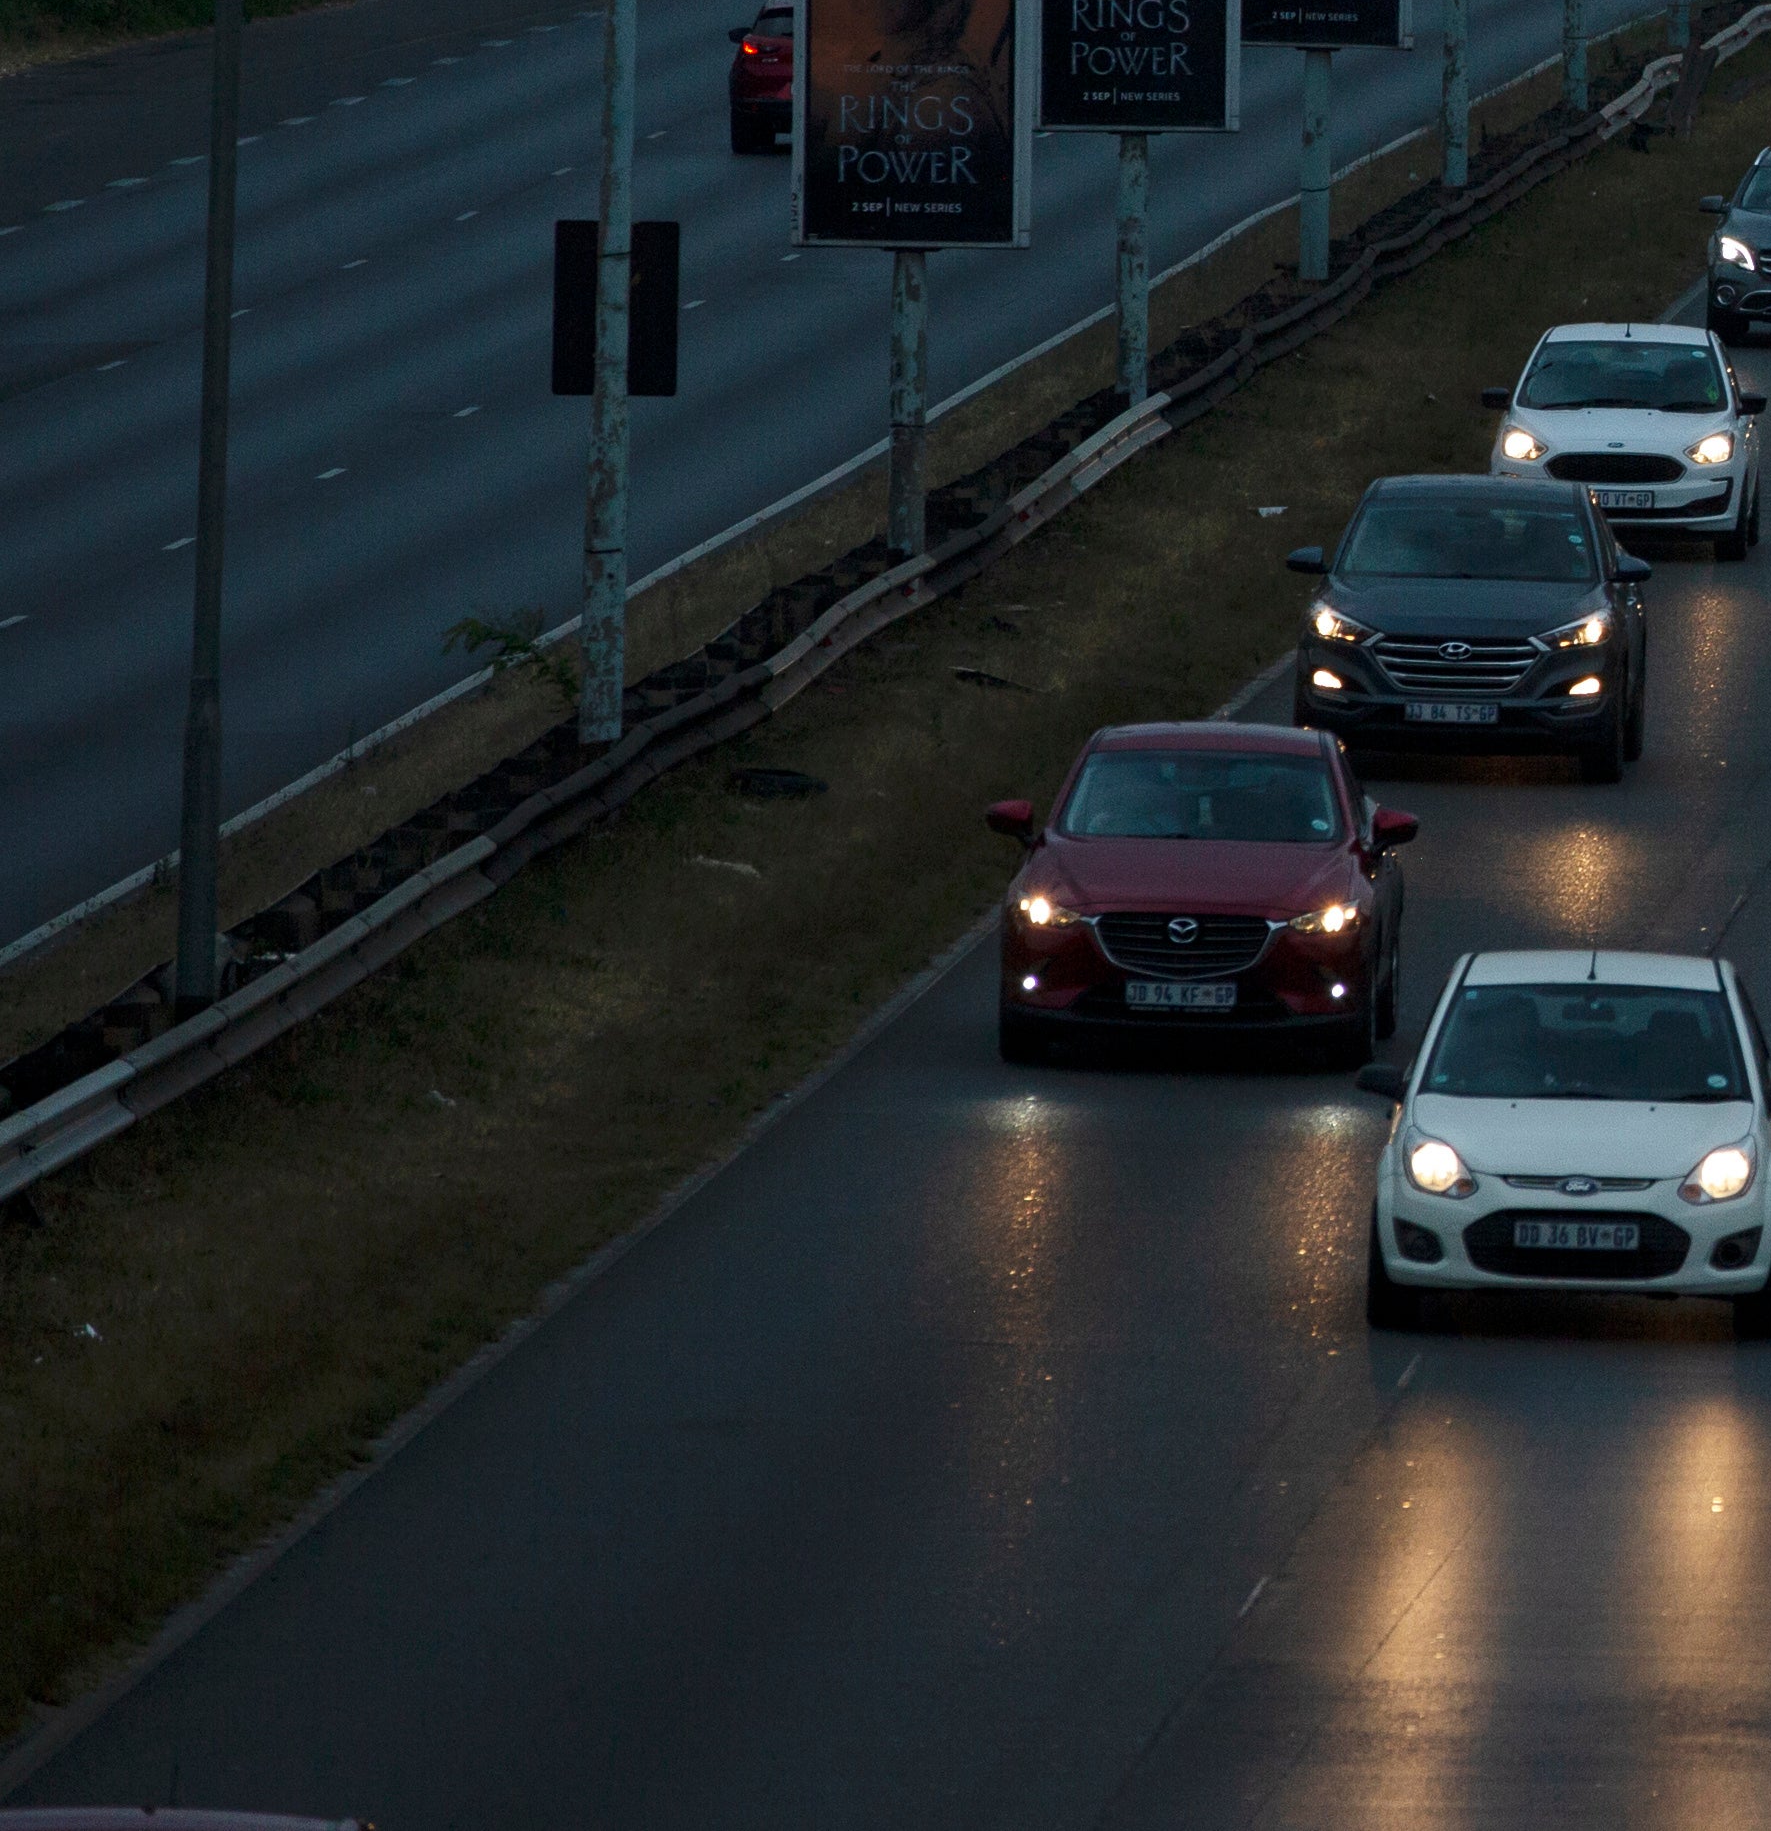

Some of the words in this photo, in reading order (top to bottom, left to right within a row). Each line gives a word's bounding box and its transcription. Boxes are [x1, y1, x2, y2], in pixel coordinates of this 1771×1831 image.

[1280, 11, 1296, 20] SEP
[1305, 12, 1327, 21] NEW
[1328, 13, 1359, 22] SERIES
[1120, 31, 1137, 41] OF
[1071, 41, 1194, 76] POWER
[866, 64, 893, 74] LORD
[896, 64, 910, 74] OF
[914, 64, 934, 74] THE
[891, 80, 918, 93] THE
[1082, 91, 1090, 101] 2
[1092, 91, 1111, 101] SEP
[1120, 91, 1144, 101] NEW
[1146, 92, 1181, 102] SERIES
[839, 95, 974, 136] RINGS
[895, 134, 913, 145] OF
[837, 145, 979, 184] POWER
[851, 201, 860, 212] 2
[862, 201, 884, 212] SEP
[894, 202, 921, 213] NEW
[923, 202, 963, 214] SERIES
[1614, 492, 1627, 505] VT
[1636, 492, 1650, 506] GP
[1431, 704, 1446, 719] 84
[1456, 704, 1471, 720] TS
[1479, 706, 1495, 721] GP
[1154, 984, 1172, 1002] 94
[1181, 985, 1199, 1003] KF
[1214, 986, 1234, 1004] GP
[1547, 1224, 1568, 1244] 36
[1577, 1225, 1600, 1245] BV
[1612, 1226, 1635, 1246] GP
